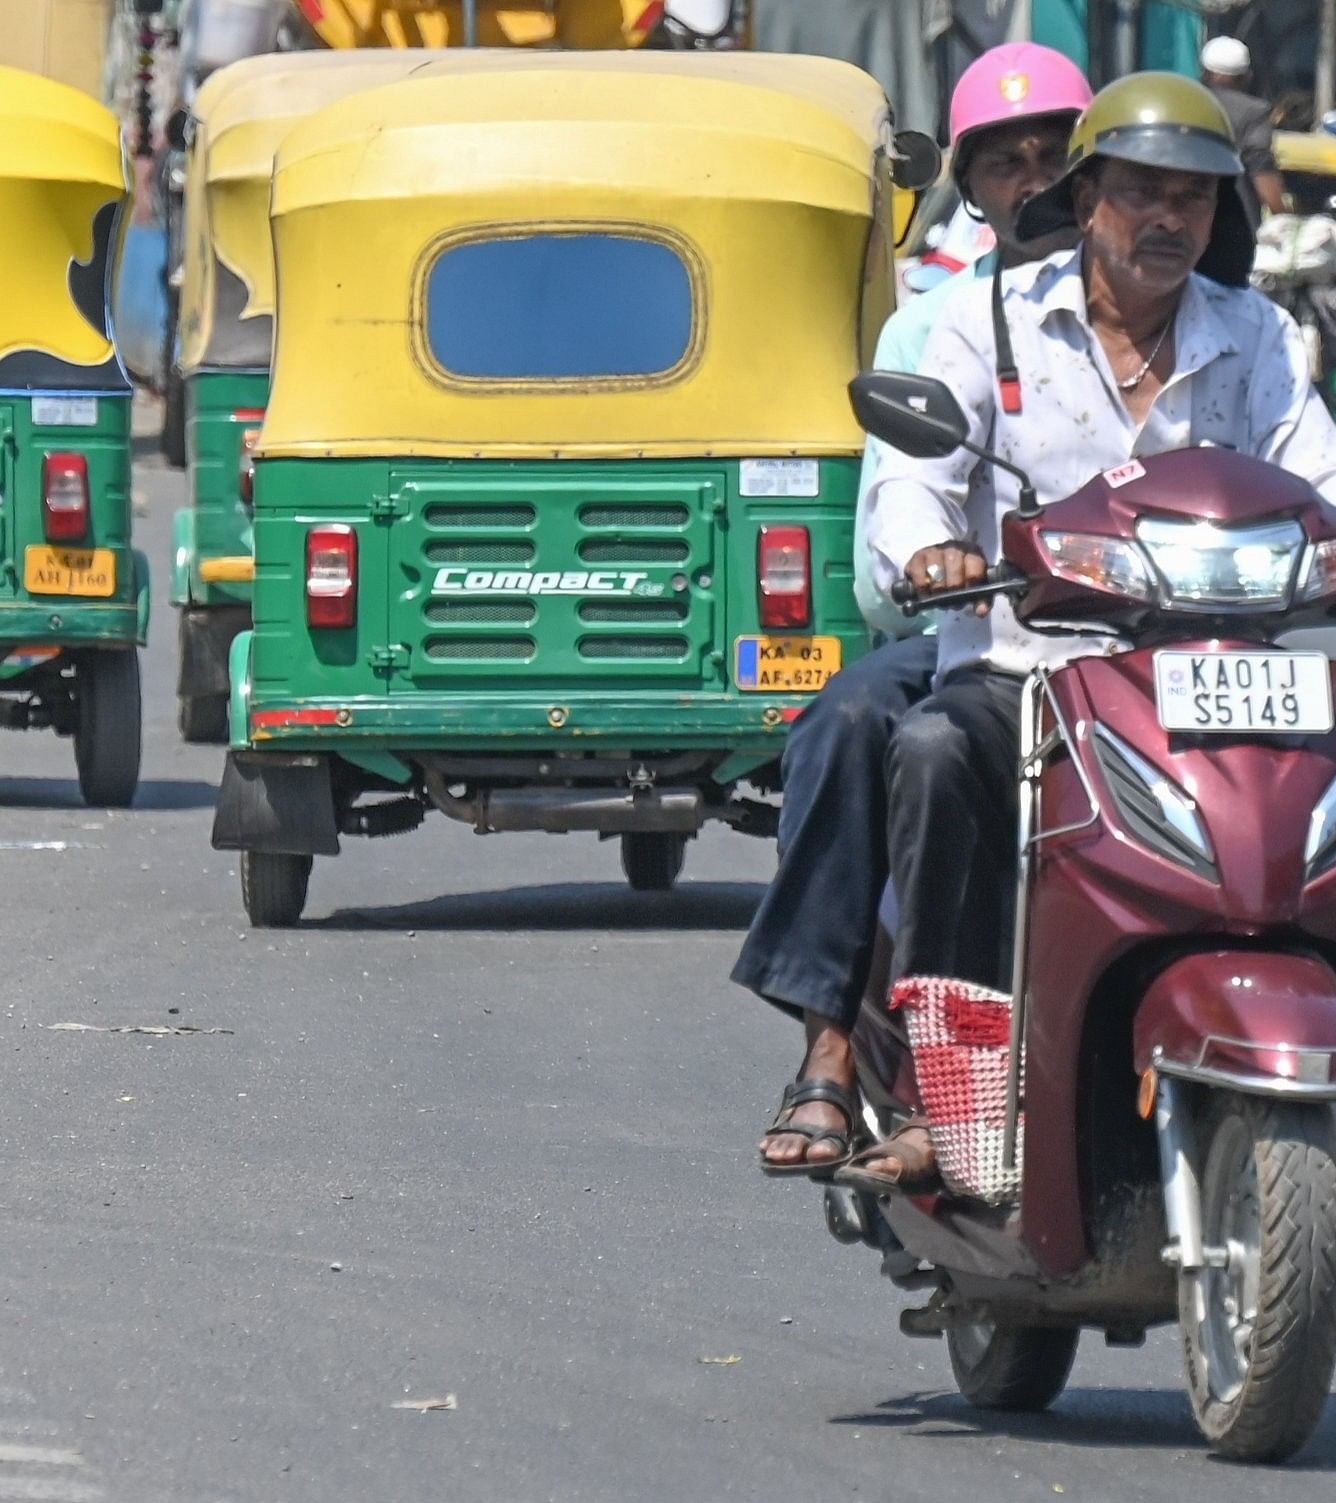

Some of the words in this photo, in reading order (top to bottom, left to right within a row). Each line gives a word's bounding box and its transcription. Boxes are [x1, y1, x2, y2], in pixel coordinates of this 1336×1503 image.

[760, 647, 784, 660] KA
[801, 647, 822, 660] 03
[1191, 658, 1296, 690] KA01J
[1194, 693, 1299, 726] S5149
